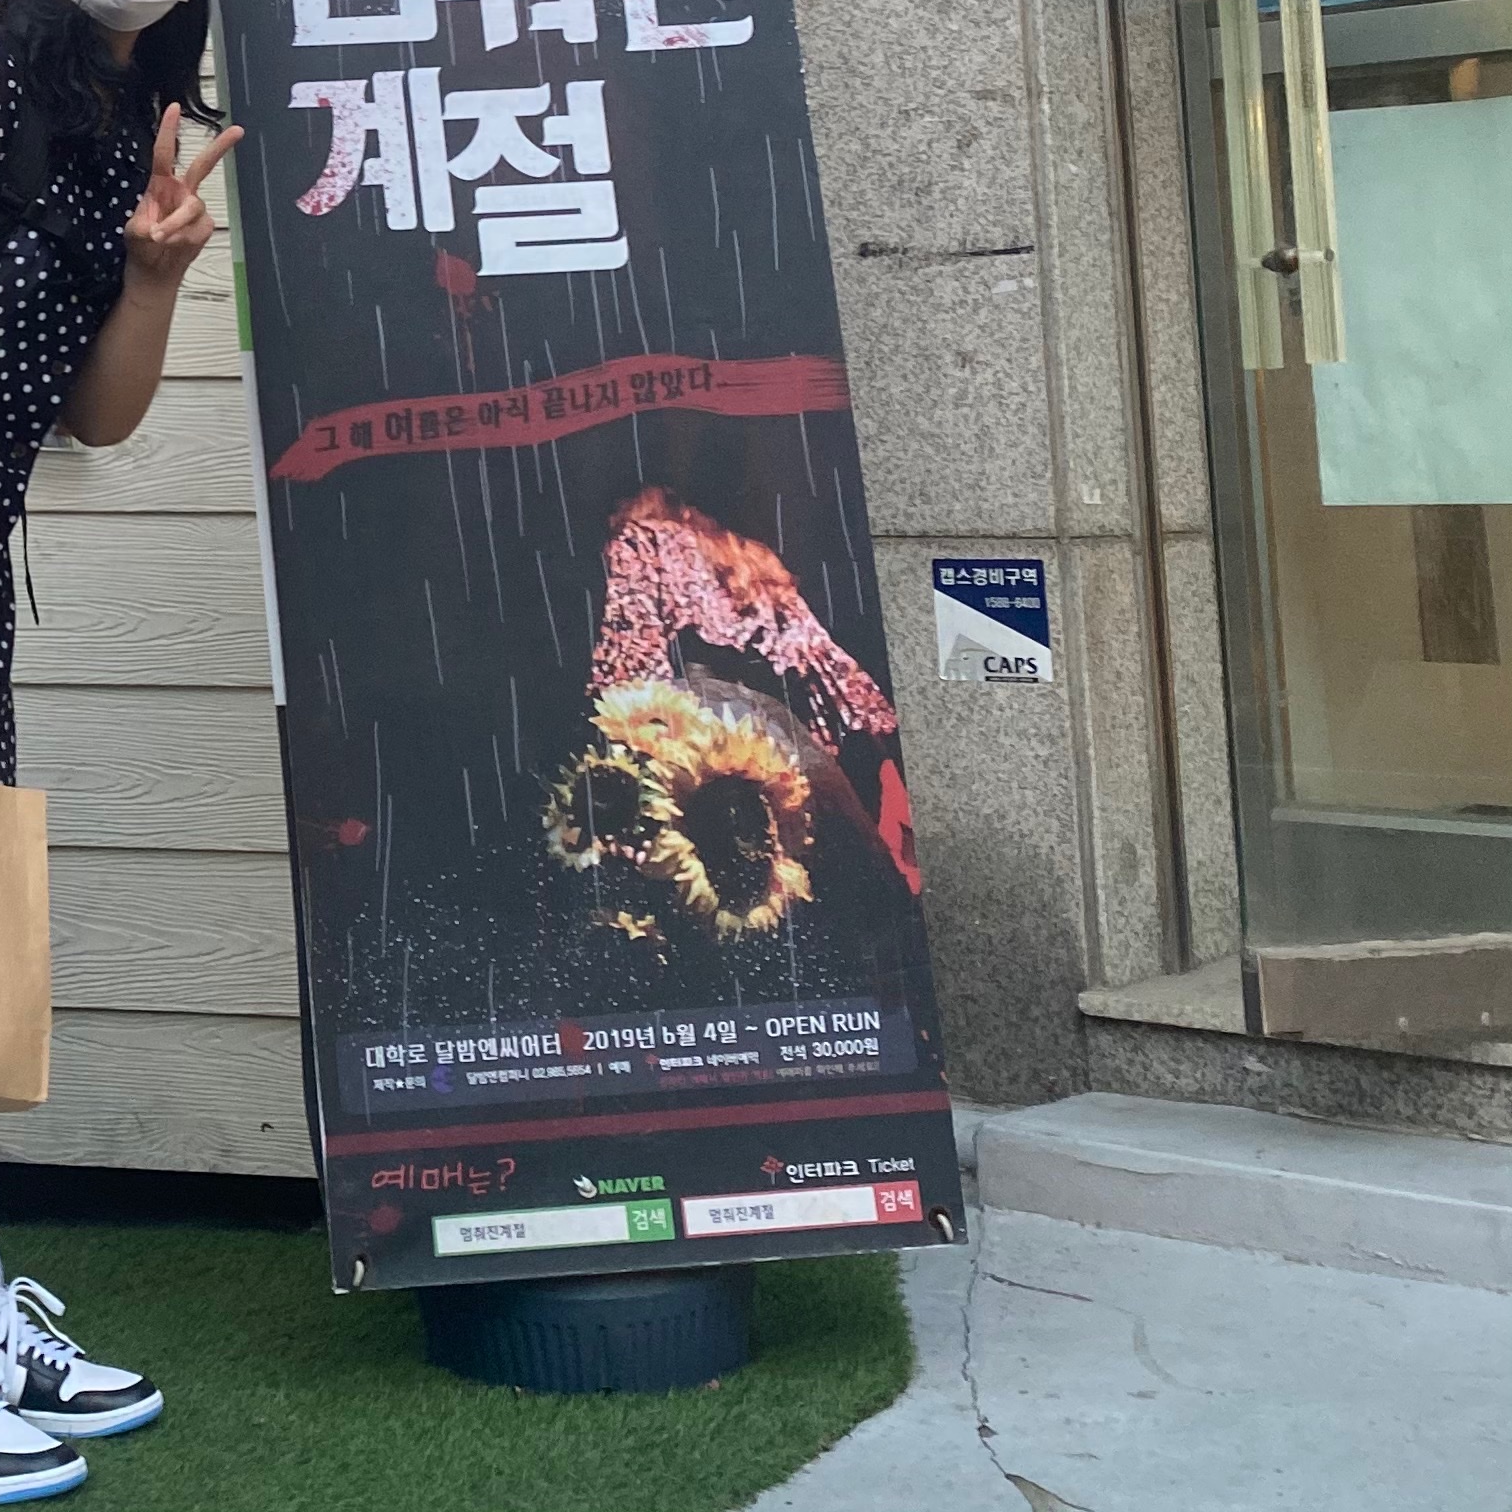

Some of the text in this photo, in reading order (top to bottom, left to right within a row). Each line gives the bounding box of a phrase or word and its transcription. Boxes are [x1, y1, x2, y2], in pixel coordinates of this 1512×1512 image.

[288, 66, 629, 277] 계절
[314, 426, 341, 453] 그
[349, 419, 374, 451] 해
[386, 405, 467, 446] 여름은
[477, 393, 531, 429] 아직
[542, 379, 622, 420] 끝나지
[983, 656, 1038, 675] CAPS
[365, 1043, 429, 1069] 대학로
[434, 1032, 563, 1066] 달밤엔씨어터
[582, 1025, 656, 1051] 2019년
[702, 1019, 738, 1045] 4일
[764, 1014, 827, 1038] OPEN
[831, 1011, 881, 1033] RUN
[779, 1044, 808, 1062] 전석
[370, 1156, 516, 1196] 예매는?
[785, 1156, 916, 1184] 인터파크 Ticket
[597, 1175, 666, 1196] NAVER
[878, 1188, 916, 1213] 검색
[631, 1206, 667, 1232] 검색
